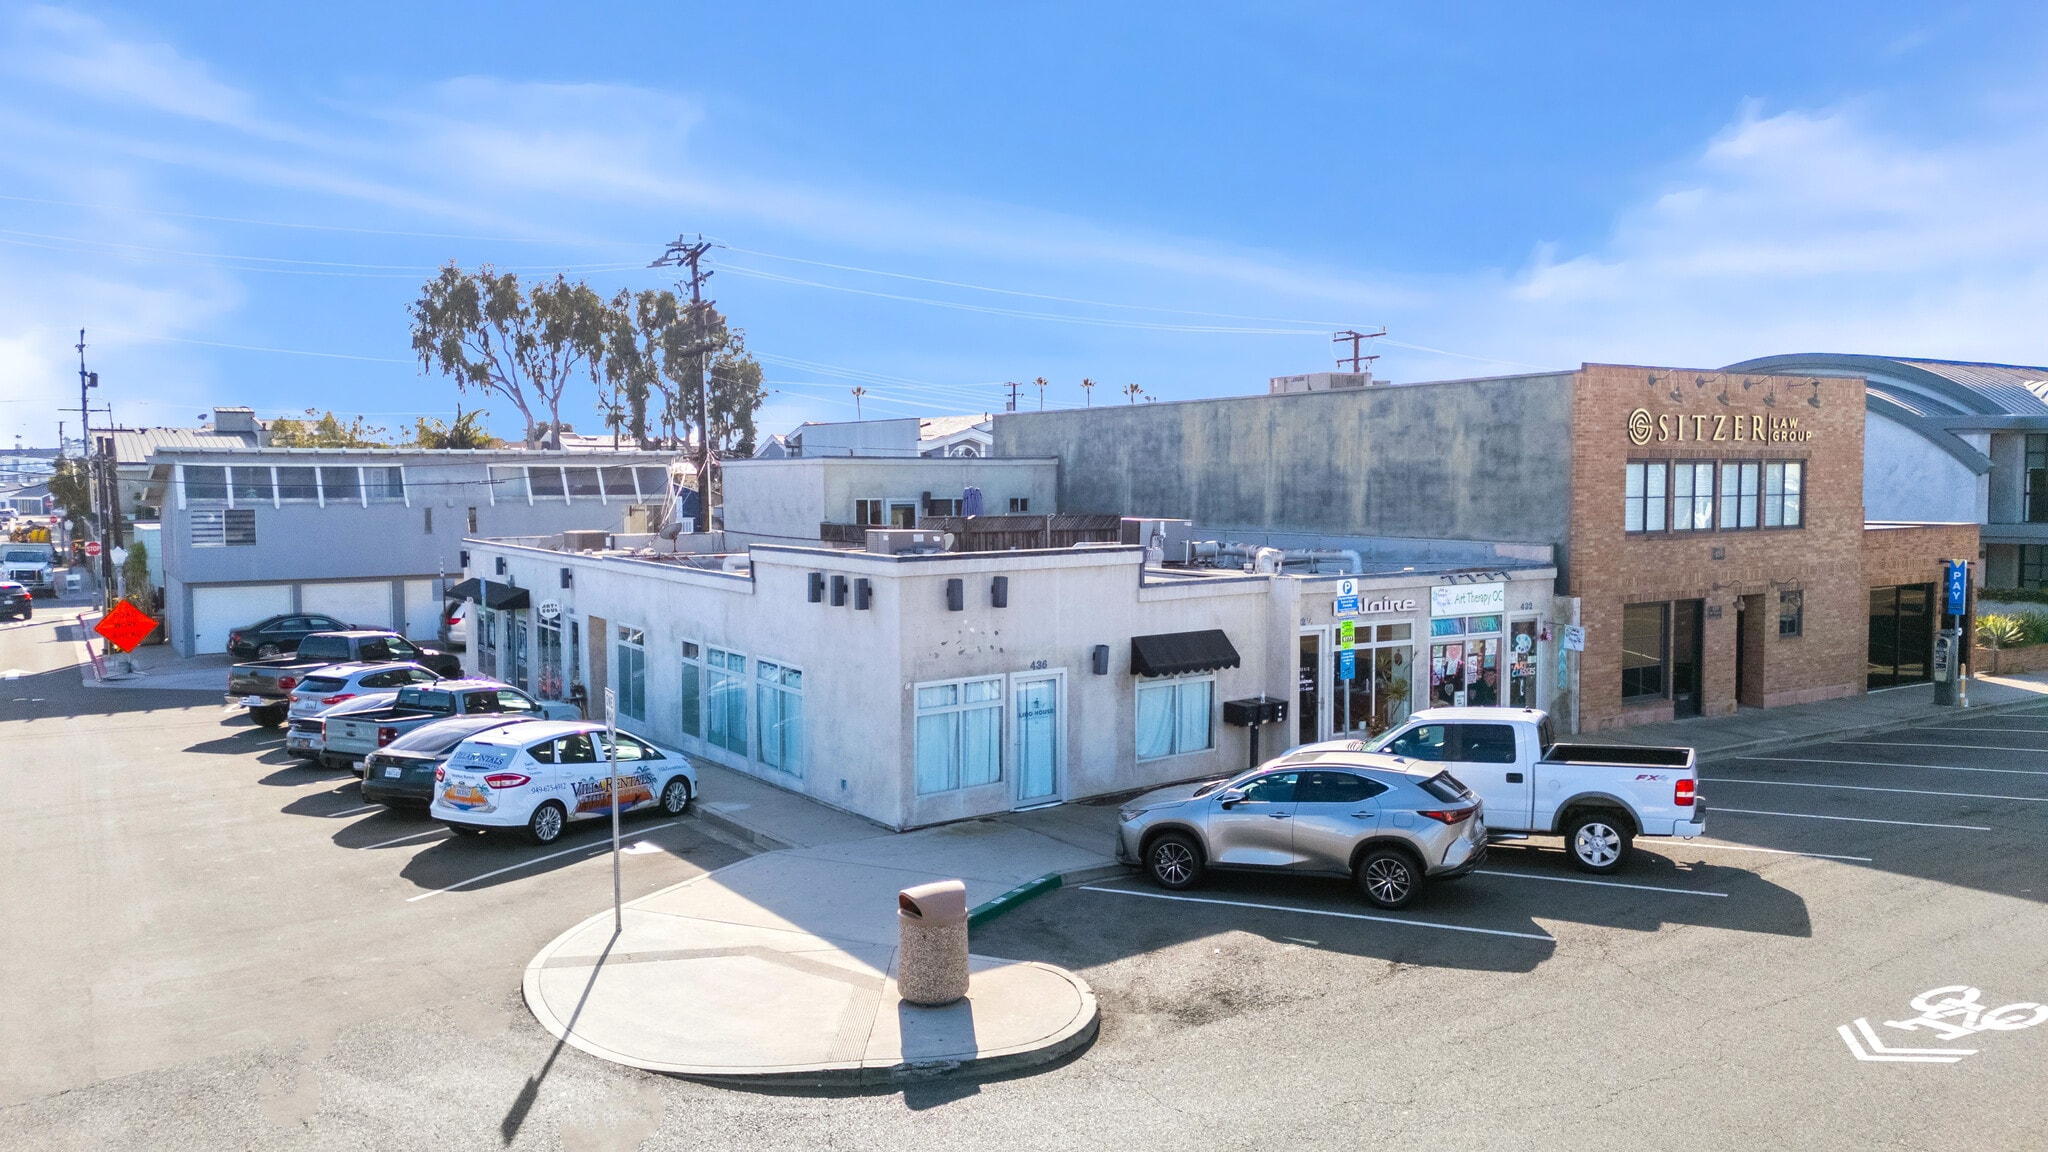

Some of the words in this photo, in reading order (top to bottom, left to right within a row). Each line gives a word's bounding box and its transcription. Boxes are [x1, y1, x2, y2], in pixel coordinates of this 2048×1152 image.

[1657, 414, 1767, 443] SITZER
[1772, 417, 1799, 430] LAW
[1772, 430, 1813, 443] GROUP
[86, 544, 101, 552] STOP
[1952, 571, 1962, 600] PAY
[1520, 602, 1533, 610] 432
[114, 621, 137, 629] WORK
[1030, 660, 1048, 670] 436
[1034, 708, 1054, 716] HOUSE
